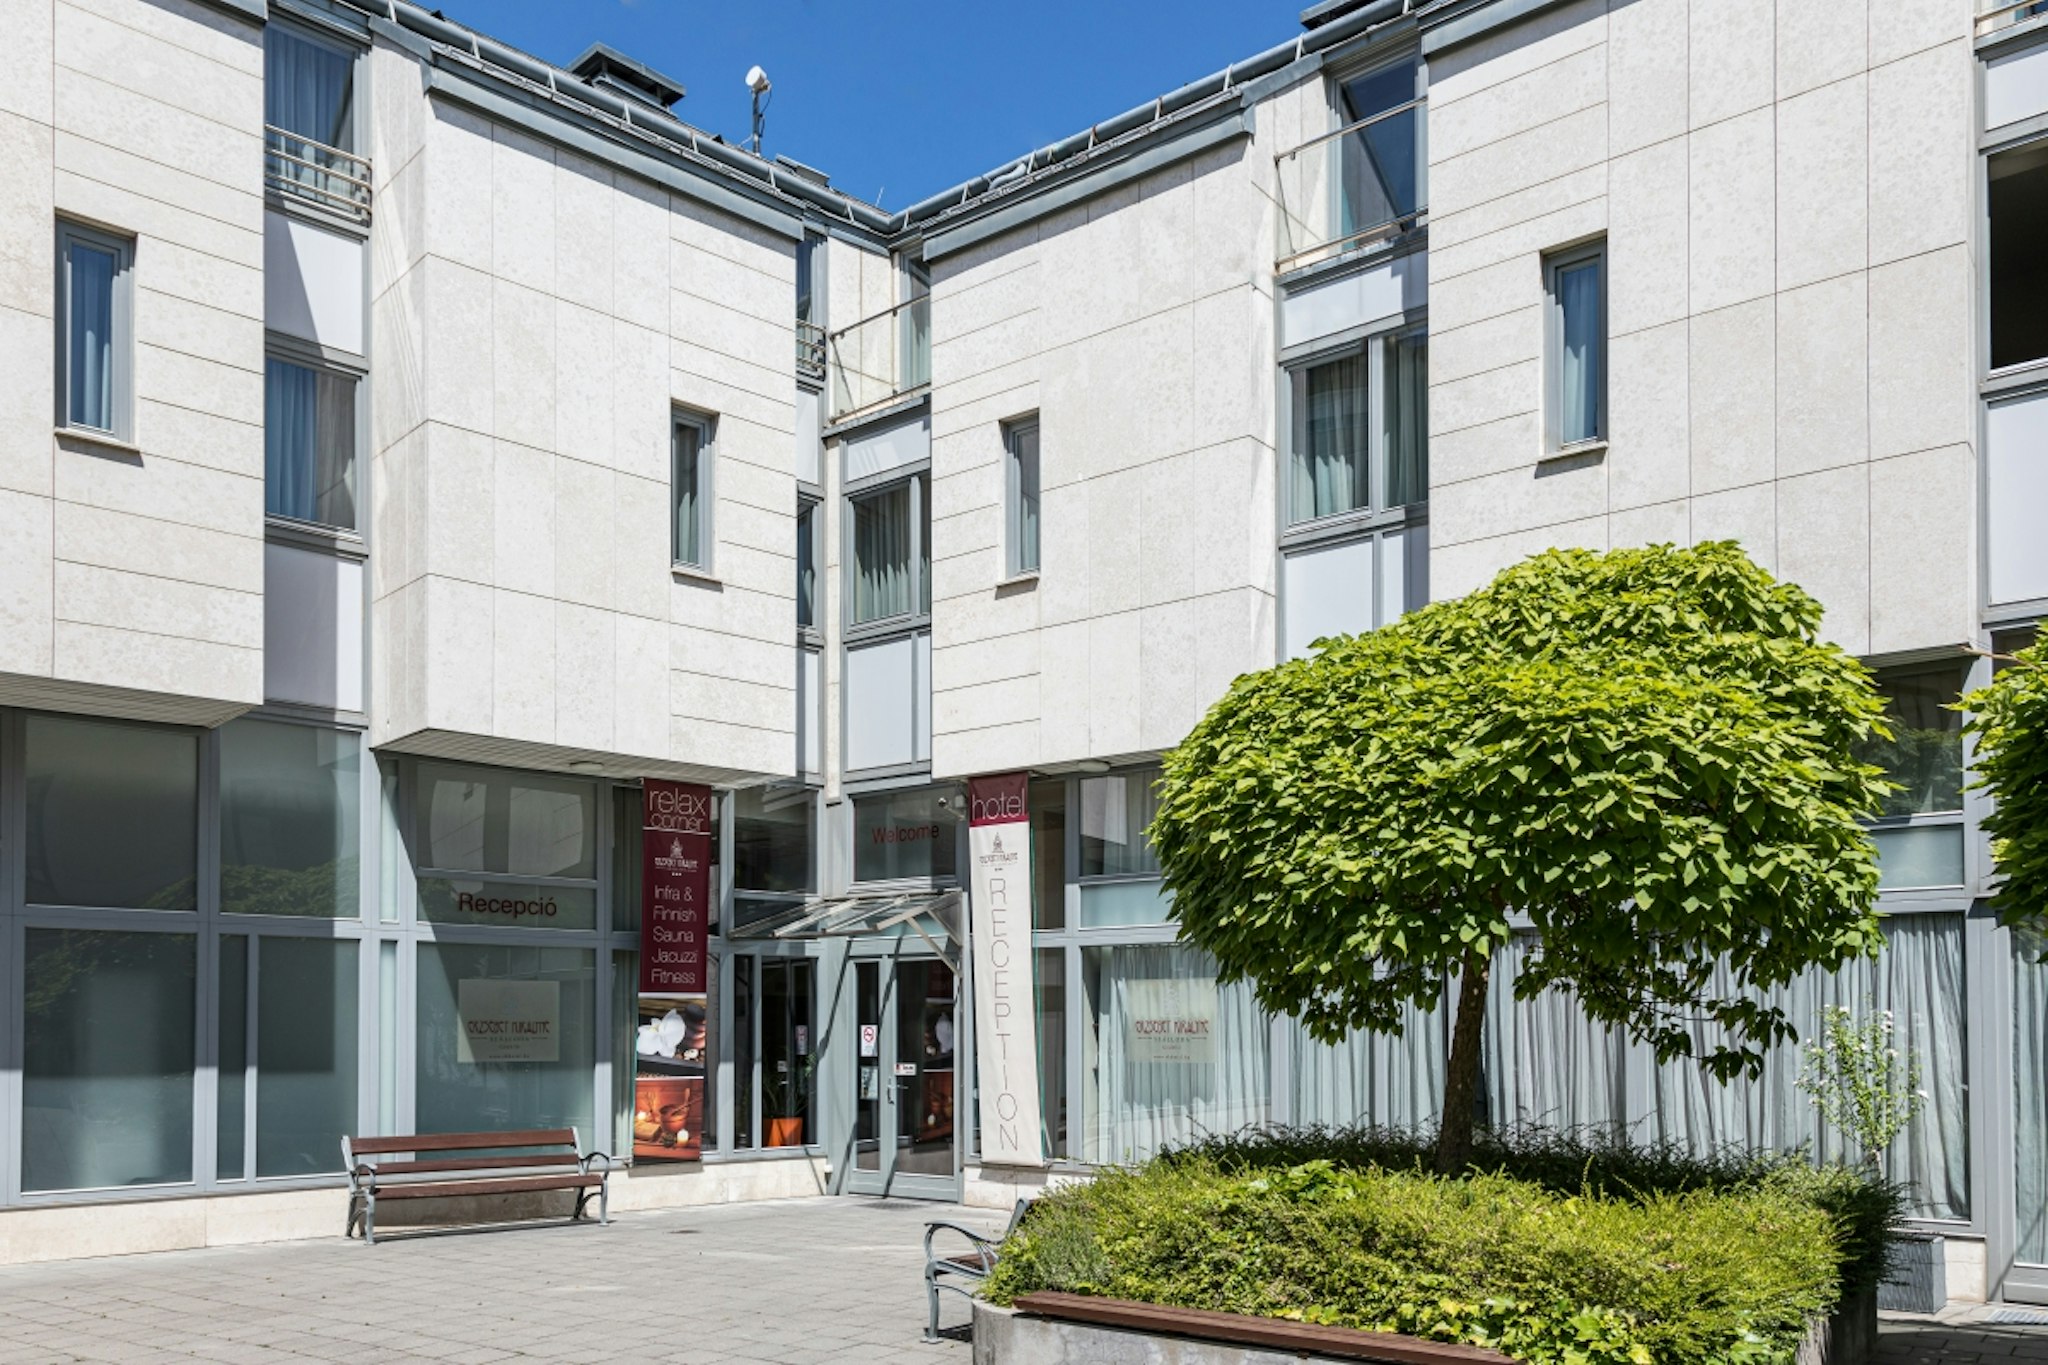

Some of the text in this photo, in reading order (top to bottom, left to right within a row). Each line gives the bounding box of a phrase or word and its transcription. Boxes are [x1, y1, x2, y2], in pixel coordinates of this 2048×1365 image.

[648, 787, 707, 817] relax
[971, 787, 1026, 821] hotel
[650, 813, 705, 832] corner
[871, 825, 940, 844] Welcome
[654, 884, 694, 902] Infra &
[458, 891, 558, 919] Recepció
[652, 904, 697, 923] Finnish
[652, 926, 695, 943] Sauna
[651, 947, 698, 965] Jacuzzi
[651, 967, 697, 985] Fitness
[989, 877, 1018, 1151] RECEPTION
